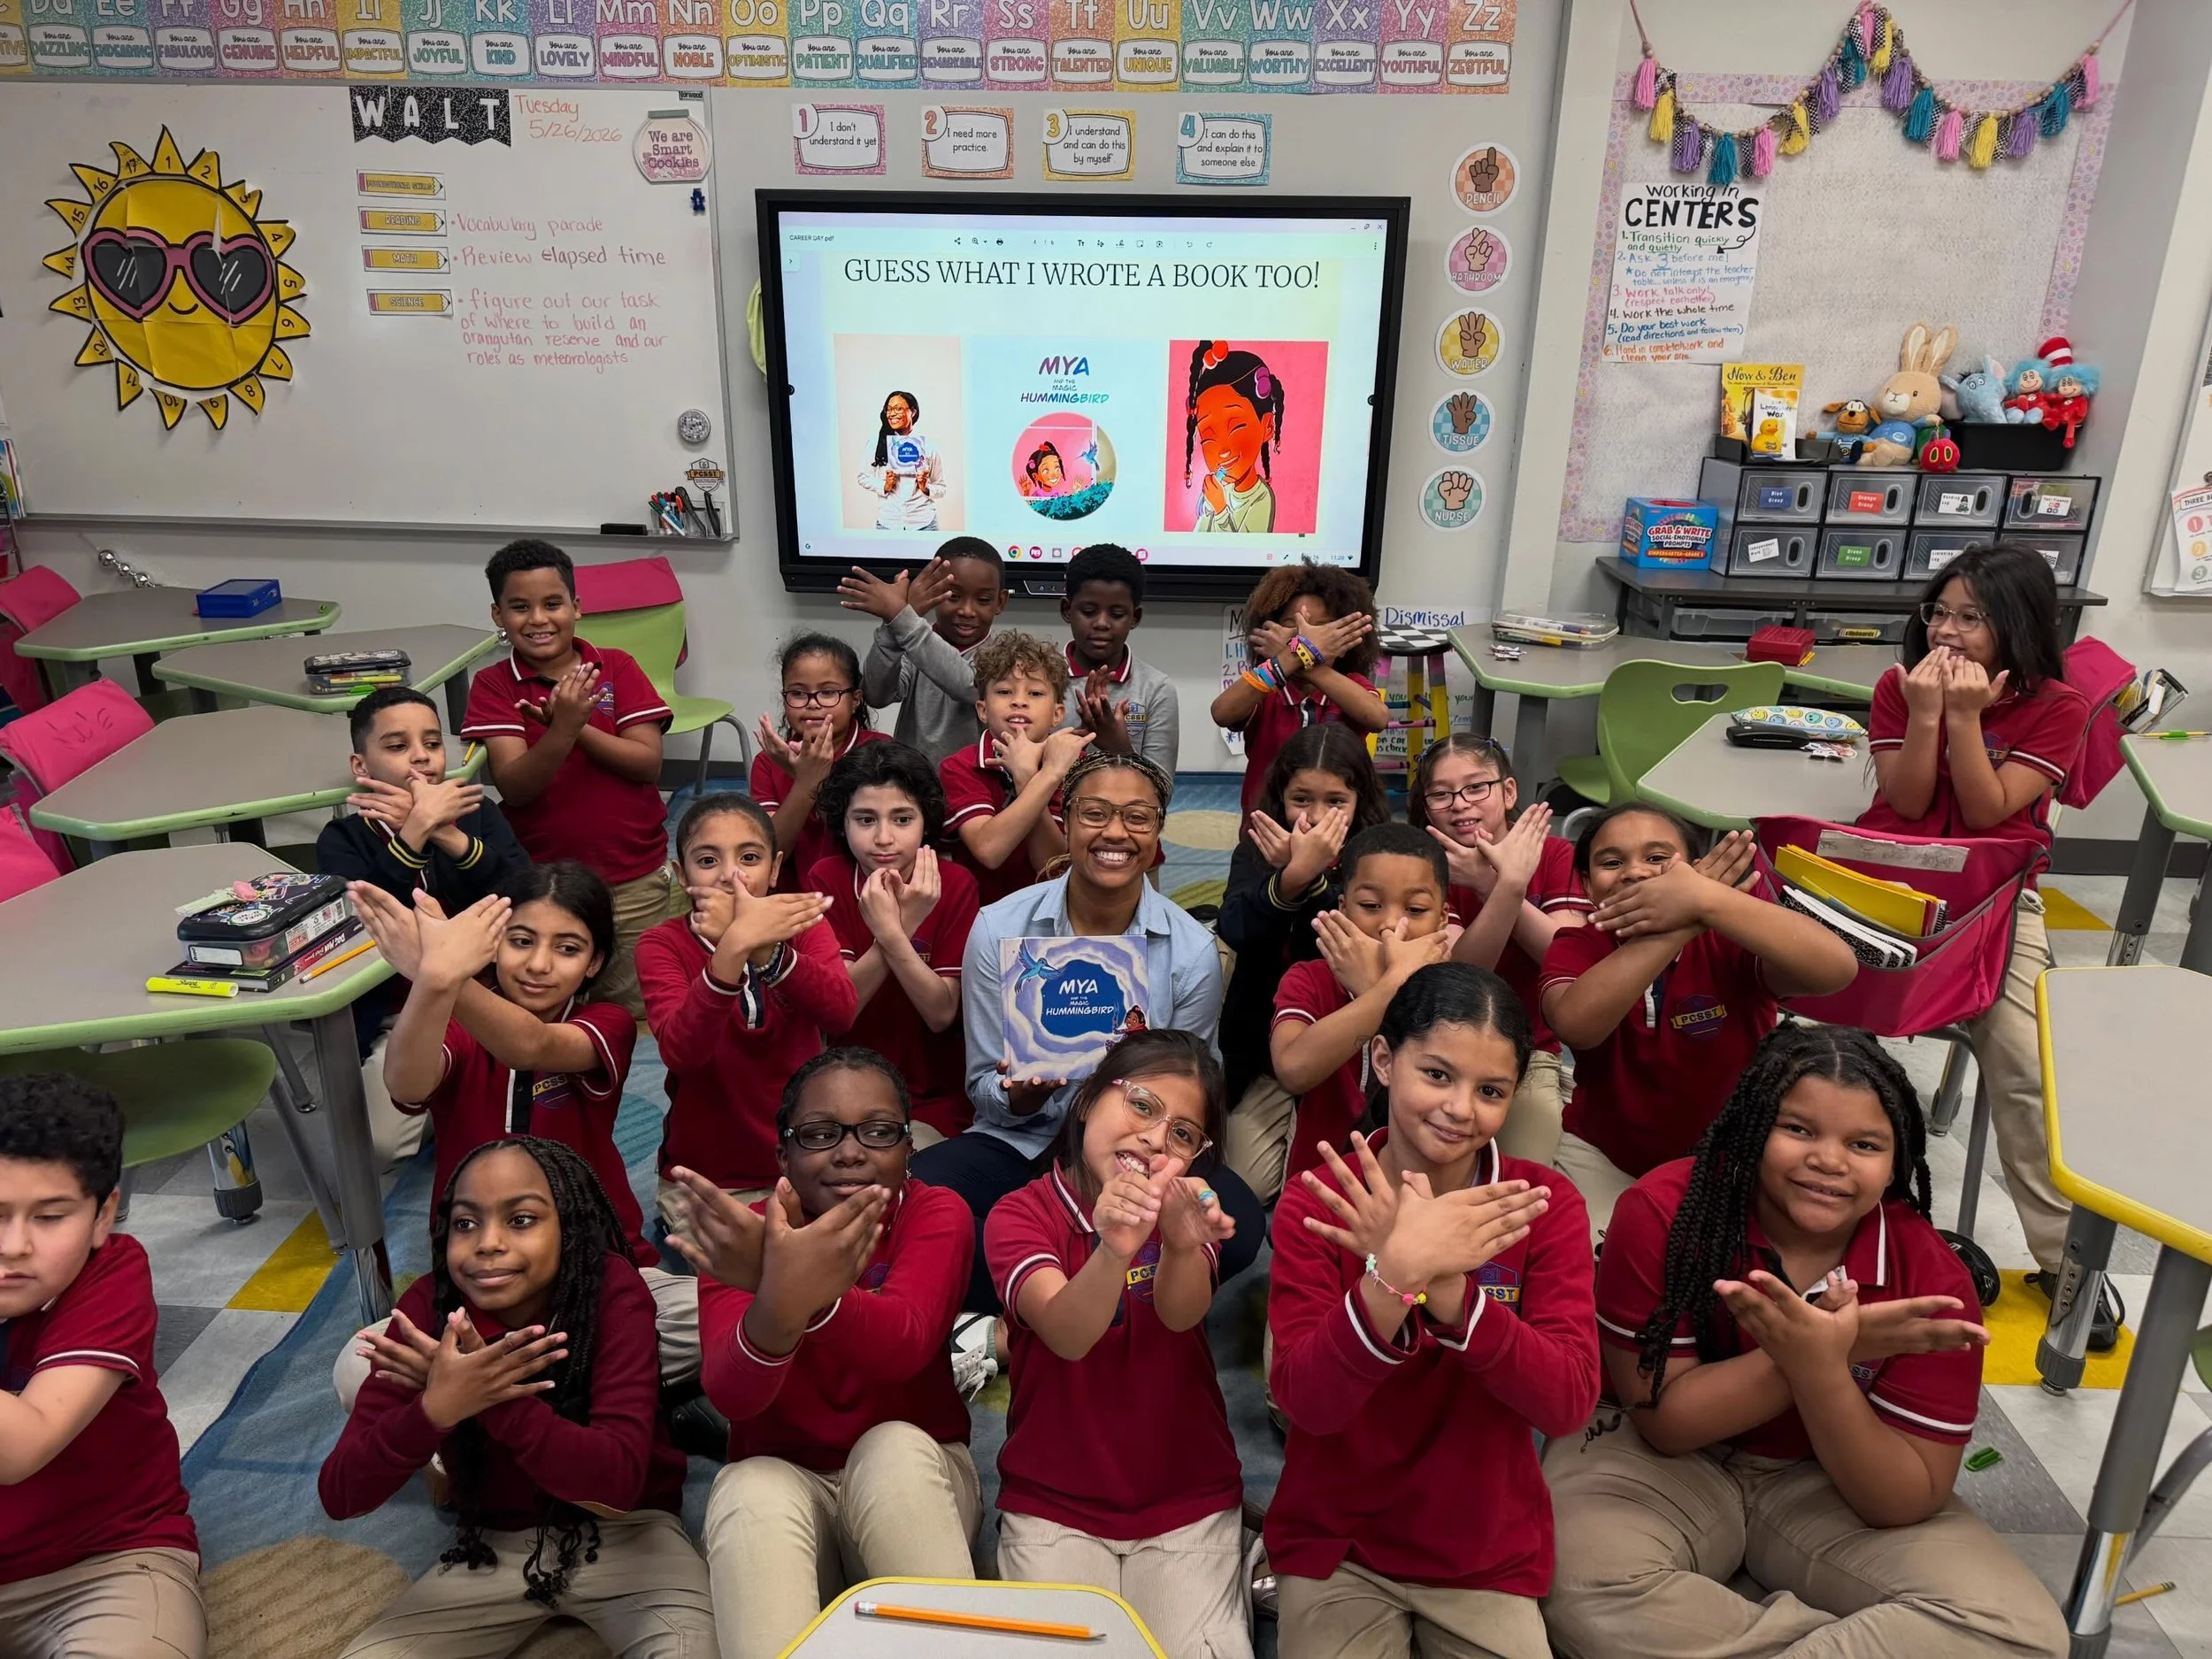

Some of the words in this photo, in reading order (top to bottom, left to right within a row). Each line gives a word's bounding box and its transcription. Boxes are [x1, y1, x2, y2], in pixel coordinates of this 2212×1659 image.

[730, 0, 778, 27] Oo
[1000, 0, 1033, 30] Ss
[1250, 0, 1313, 31] Ww
[1463, 0, 1501, 32] Zz
[32, 42, 90, 57] DAZZLING
[158, 44, 214, 58] FABULOUS
[485, 39, 501, 49] You
[1002, 47, 1018, 56] You
[223, 44, 276, 60] GENUINE
[285, 45, 339, 61] HELPFUL
[345, 46, 403, 62] IMPACTFUL
[413, 48, 464, 65] JOYFUL
[486, 49, 516, 65] KIND
[541, 50, 589, 67] LOVELY
[603, 50, 658, 68] MINDFUL
[673, 51, 714, 68] NOBLE
[1464, 50, 1479, 58] You
[727, 54, 786, 68] OPTIMISTIC
[796, 53, 849, 70] PATIENT
[856, 54, 918, 70] QUALIFIED
[990, 55, 1044, 72] STRONG
[1052, 57, 1112, 73] TALENTED
[1125, 58, 1172, 73] UNIQUE
[1182, 58, 1244, 73] VALUABLE
[1249, 59, 1310, 74] WORTHY
[1382, 59, 1441, 74] YOUTHFUL
[1449, 59, 1506, 75] ZESTFUL
[356, 96, 500, 130] WALT
[516, 95, 580, 121] Tuesday
[799, 108, 808, 132] 1
[836, 122, 856, 132] don't
[924, 110, 938, 134] 2
[1047, 113, 1060, 138] 3
[1180, 114, 1195, 138] 4
[530, 120, 622, 142] 5/26/2026
[649, 130, 672, 142] We
[676, 132, 693, 142] are
[953, 127, 973, 138] need
[975, 130, 997, 139] more
[1075, 126, 1120, 136] understand
[1229, 129, 1240, 139] do
[1241, 129, 1256, 139] this
[809, 136, 856, 146] understand
[952, 142, 988, 154] practice.
[1064, 140, 1079, 150] and
[1098, 140, 1110, 150] do
[1111, 141, 1126, 150] this
[652, 143, 692, 156] Smart
[1197, 144, 1213, 153] and
[1215, 144, 1244, 155] explain
[1254, 145, 1263, 154] to
[649, 157, 699, 169] Cookies
[1073, 154, 1085, 165] by
[1201, 158, 1237, 167] someone
[1465, 192, 1502, 204] PENCIL
[1721, 184, 1740, 199] in
[385, 215, 421, 226] READING
[1625, 198, 1759, 229] CENTERS
[457, 213, 537, 241] Vocabulary
[548, 217, 603, 236] parade
[1622, 231, 1628, 240] 1.
[1630, 231, 1690, 243] Transition
[1694, 236, 1730, 246] quickly
[462, 245, 532, 265] Review
[541, 246, 607, 269] elapsed
[619, 246, 666, 265] time
[1648, 245, 1683, 254] quietly
[393, 254, 417, 264] MATH
[1629, 253, 1652, 264] Ask
[1657, 253, 1669, 269] 3
[1671, 252, 1704, 263] before
[844, 258, 930, 282] GUESS
[936, 260, 1019, 285] WHAT
[1027, 262, 1035, 286] I
[1041, 263, 1141, 287] WROTE
[1147, 264, 1165, 288] A
[1172, 264, 1248, 288] BOOK
[1255, 261, 1320, 288] TOO!
[1451, 272, 1502, 282] BATHROOM
[389, 297, 424, 307] SCIENCE
[470, 288, 532, 318] figure
[543, 293, 571, 309] out
[582, 296, 610, 309] our
[621, 291, 660, 308] task
[1609, 309, 1619, 319] 4.
[1655, 306, 1673, 318] the
[1678, 304, 1706, 315] whole
[1709, 303, 1735, 312] time
[461, 312, 477, 329] of
[486, 315, 531, 329] where
[543, 315, 559, 329] to
[573, 313, 616, 331] build
[630, 317, 646, 331] an
[1608, 324, 1617, 335] 5.
[1621, 323, 1634, 333] Do
[1638, 324, 1656, 335] your
[1659, 319, 1679, 328] best
[1681, 319, 1707, 327] work
[463, 332, 533, 353] orangutan
[545, 334, 601, 347] reserve
[615, 333, 639, 348] and
[644, 334, 668, 347] our
[467, 351, 501, 365] roles
[509, 354, 525, 365] as
[534, 350, 629, 374] meteorologists
[1038, 356, 1089, 376] MYA
[1449, 357, 1489, 371] WATER
[1728, 366, 1754, 381] Now
[1755, 369, 1766, 380] &
[1770, 366, 1797, 381] Ben
[1020, 393, 1110, 404] HUMMINGBIRD
[1442, 434, 1480, 446] TISSUE
[2185, 495, 2204, 506] THREE
[1434, 511, 1471, 522] NURSE
[1647, 526, 1674, 536] GRAB
[1675, 526, 1682, 535] &
[1683, 526, 1711, 538] WRITE
[1385, 606, 1465, 627] Dismissal
[1059, 979, 1098, 995] MYA
[1046, 1005, 1115, 1016] HUMMINGBIRD
[1682, 1009, 1717, 1024] PCSST
[534, 1075, 565, 1093] PCSS
